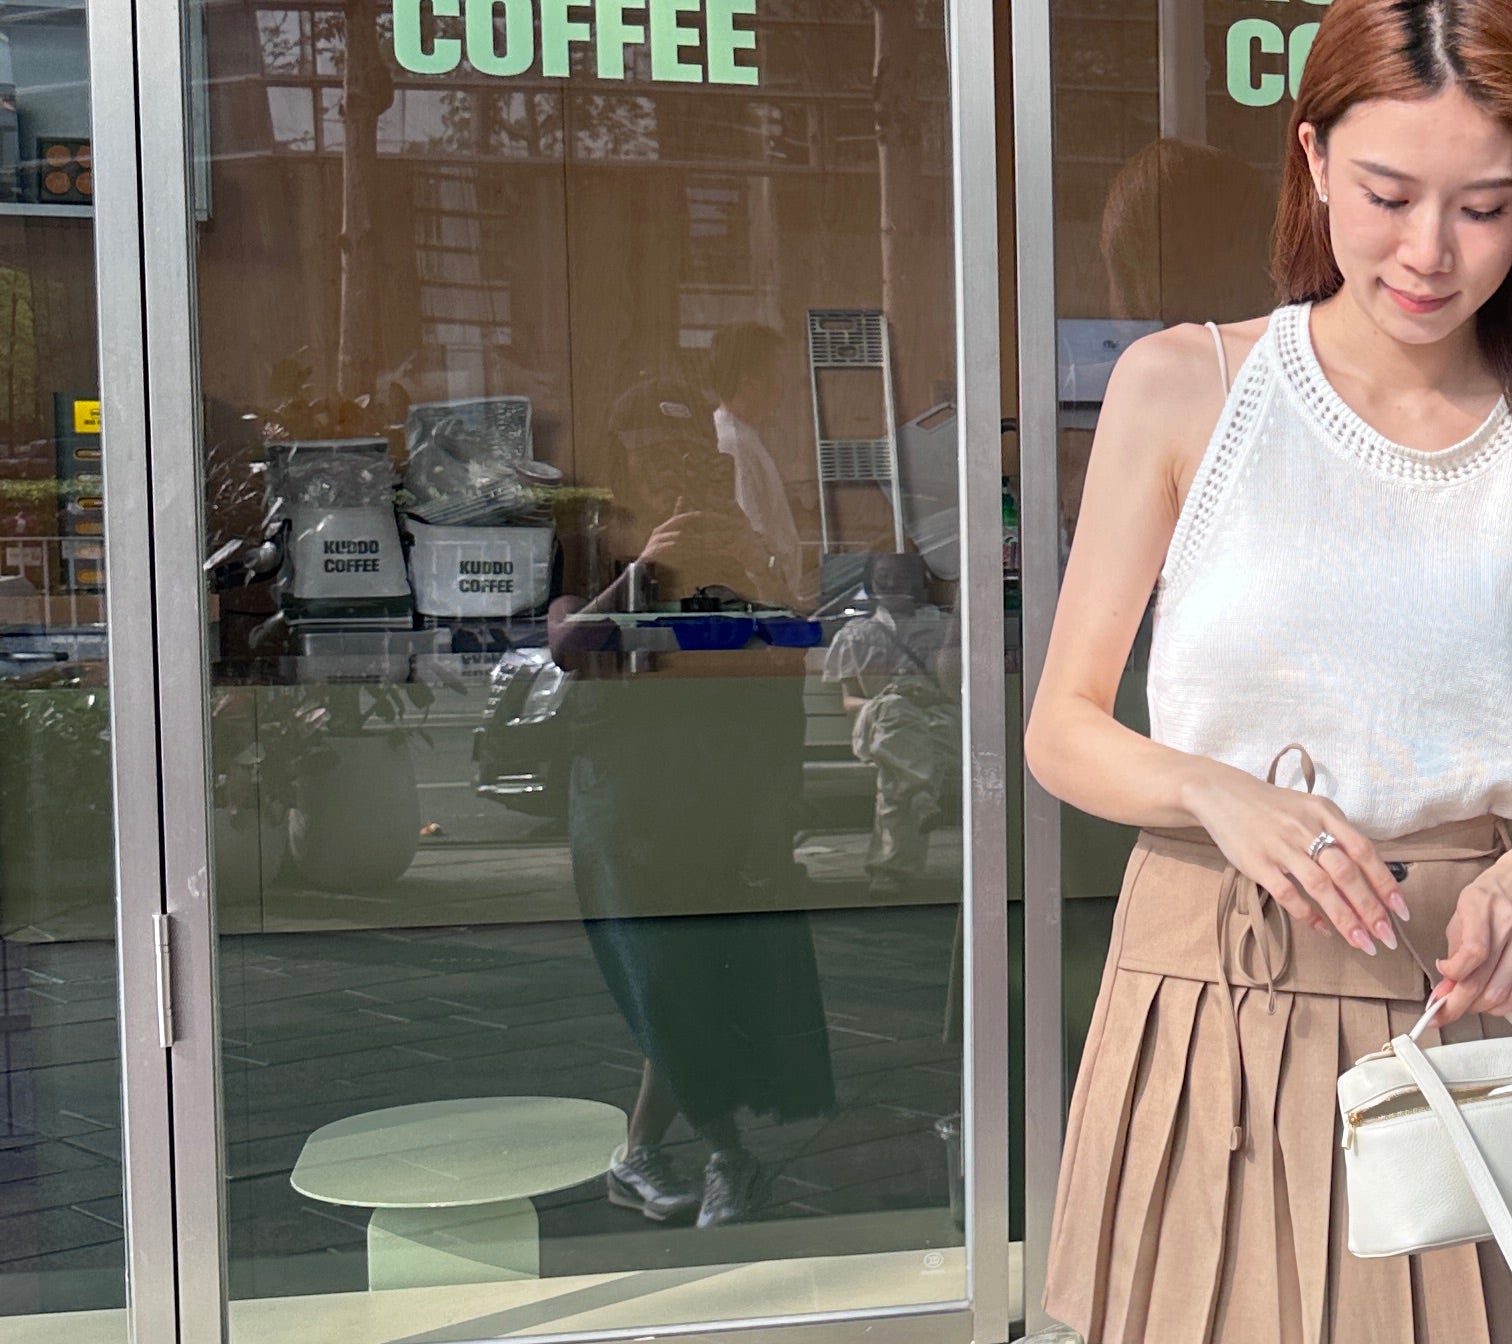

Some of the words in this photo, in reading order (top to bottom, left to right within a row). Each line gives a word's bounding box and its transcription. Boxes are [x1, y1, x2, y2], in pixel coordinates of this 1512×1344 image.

[323, 539, 379, 554] KUDDO
[323, 558, 380, 573] COFFEE
[458, 560, 514, 575] KUDDO
[458, 579, 514, 593] COFFEE
